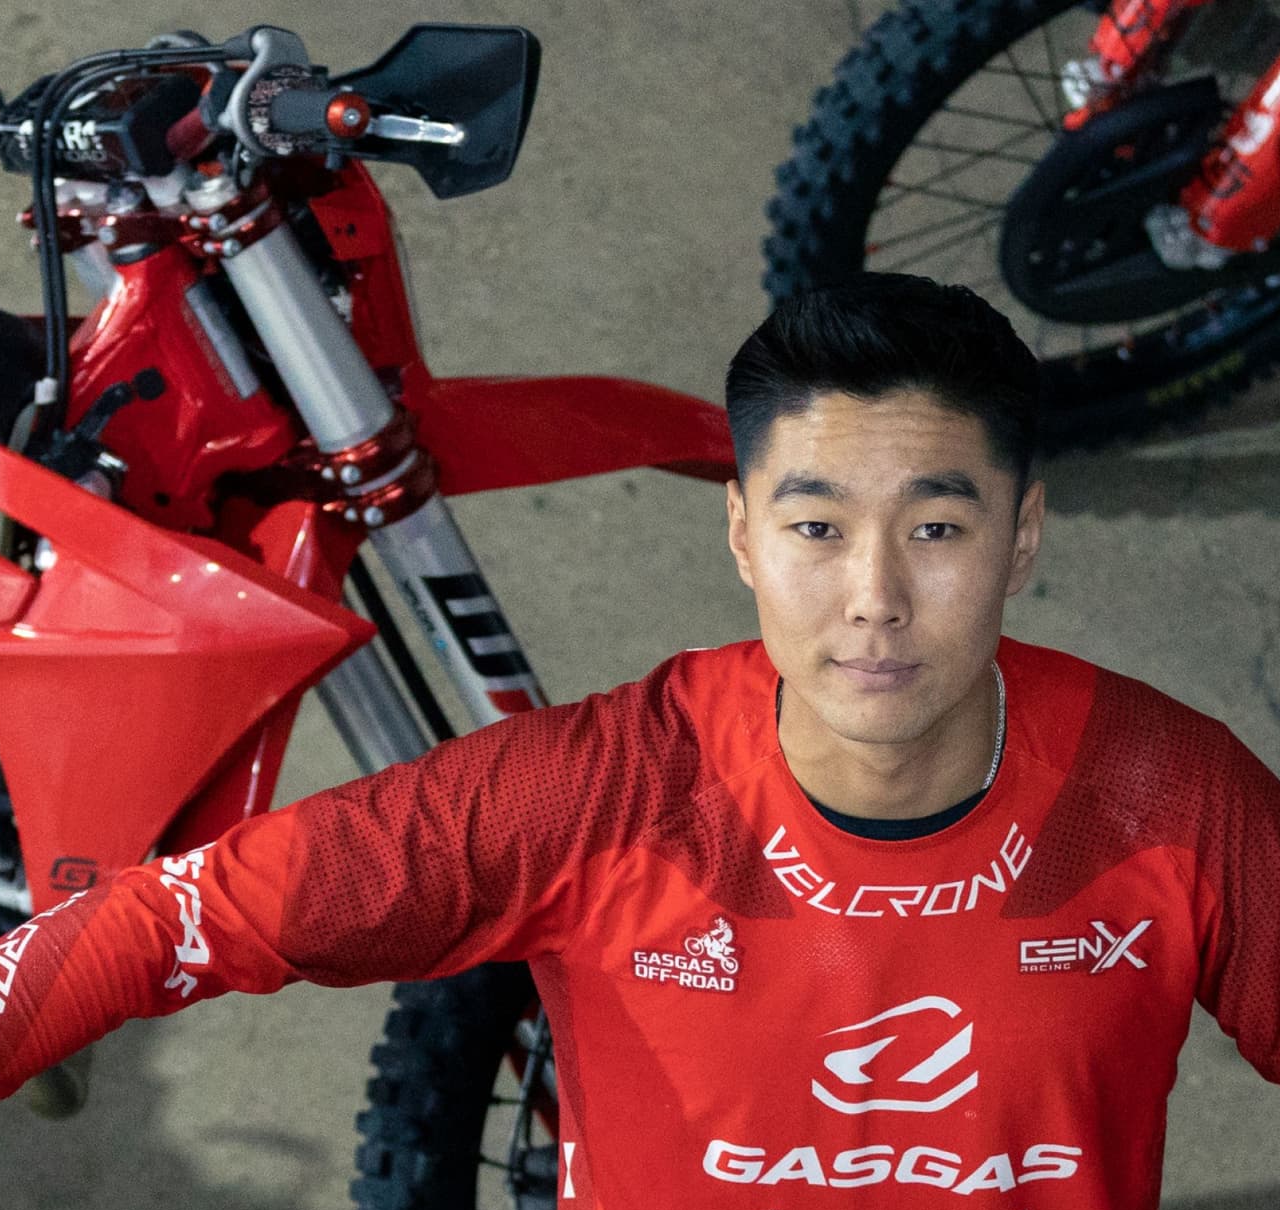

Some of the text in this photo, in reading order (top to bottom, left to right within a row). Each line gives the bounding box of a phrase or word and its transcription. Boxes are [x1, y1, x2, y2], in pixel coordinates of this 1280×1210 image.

[761, 822, 1033, 918] VELCRONE
[633, 951, 715, 974] GASGAS
[1020, 963, 1071, 972] RACING
[634, 963, 735, 992] OFF-ROAD
[702, 1139, 1083, 1195] GASGAS
